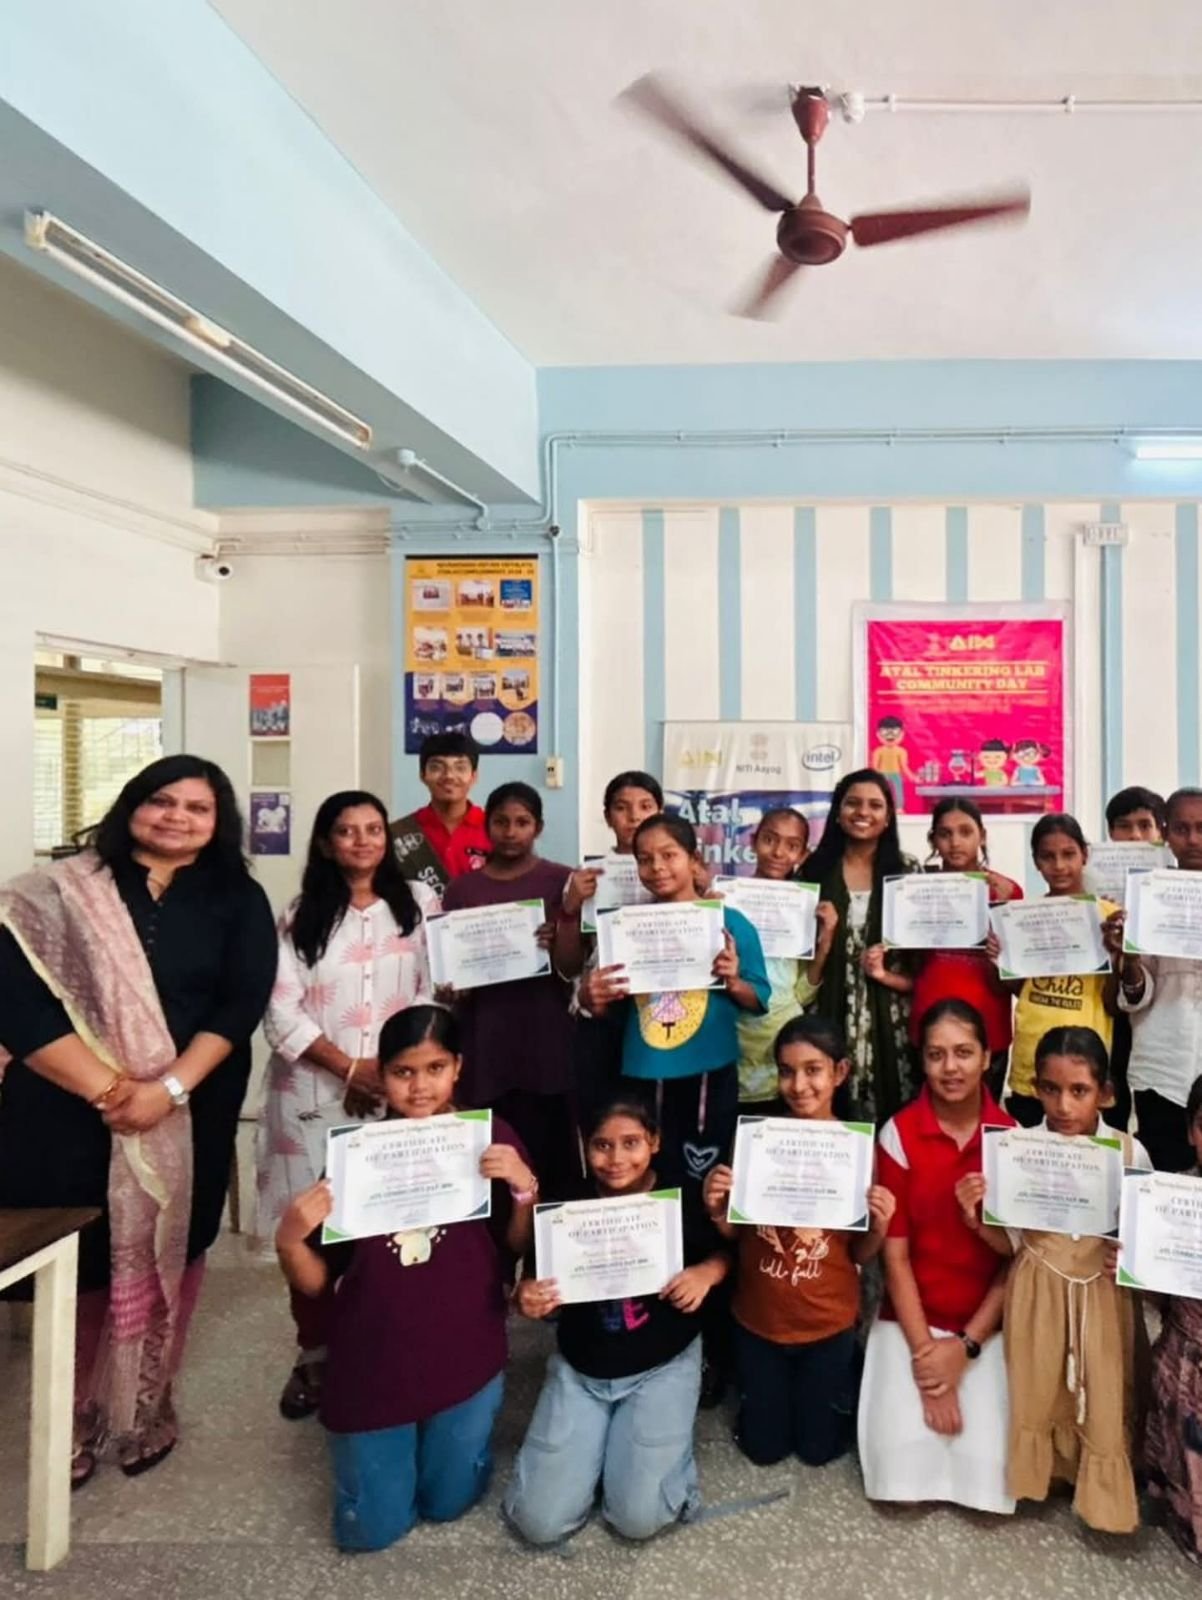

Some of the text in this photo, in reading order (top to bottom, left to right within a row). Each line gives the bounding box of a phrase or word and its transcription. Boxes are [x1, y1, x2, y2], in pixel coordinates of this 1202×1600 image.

[880, 665, 1045, 677] ATAL TINKERING LAB
[896, 677, 1028, 690] COMMUNITY DAY
[806, 751, 835, 763] intel
[678, 798, 742, 824] Atal
[696, 837, 758, 864] inke
